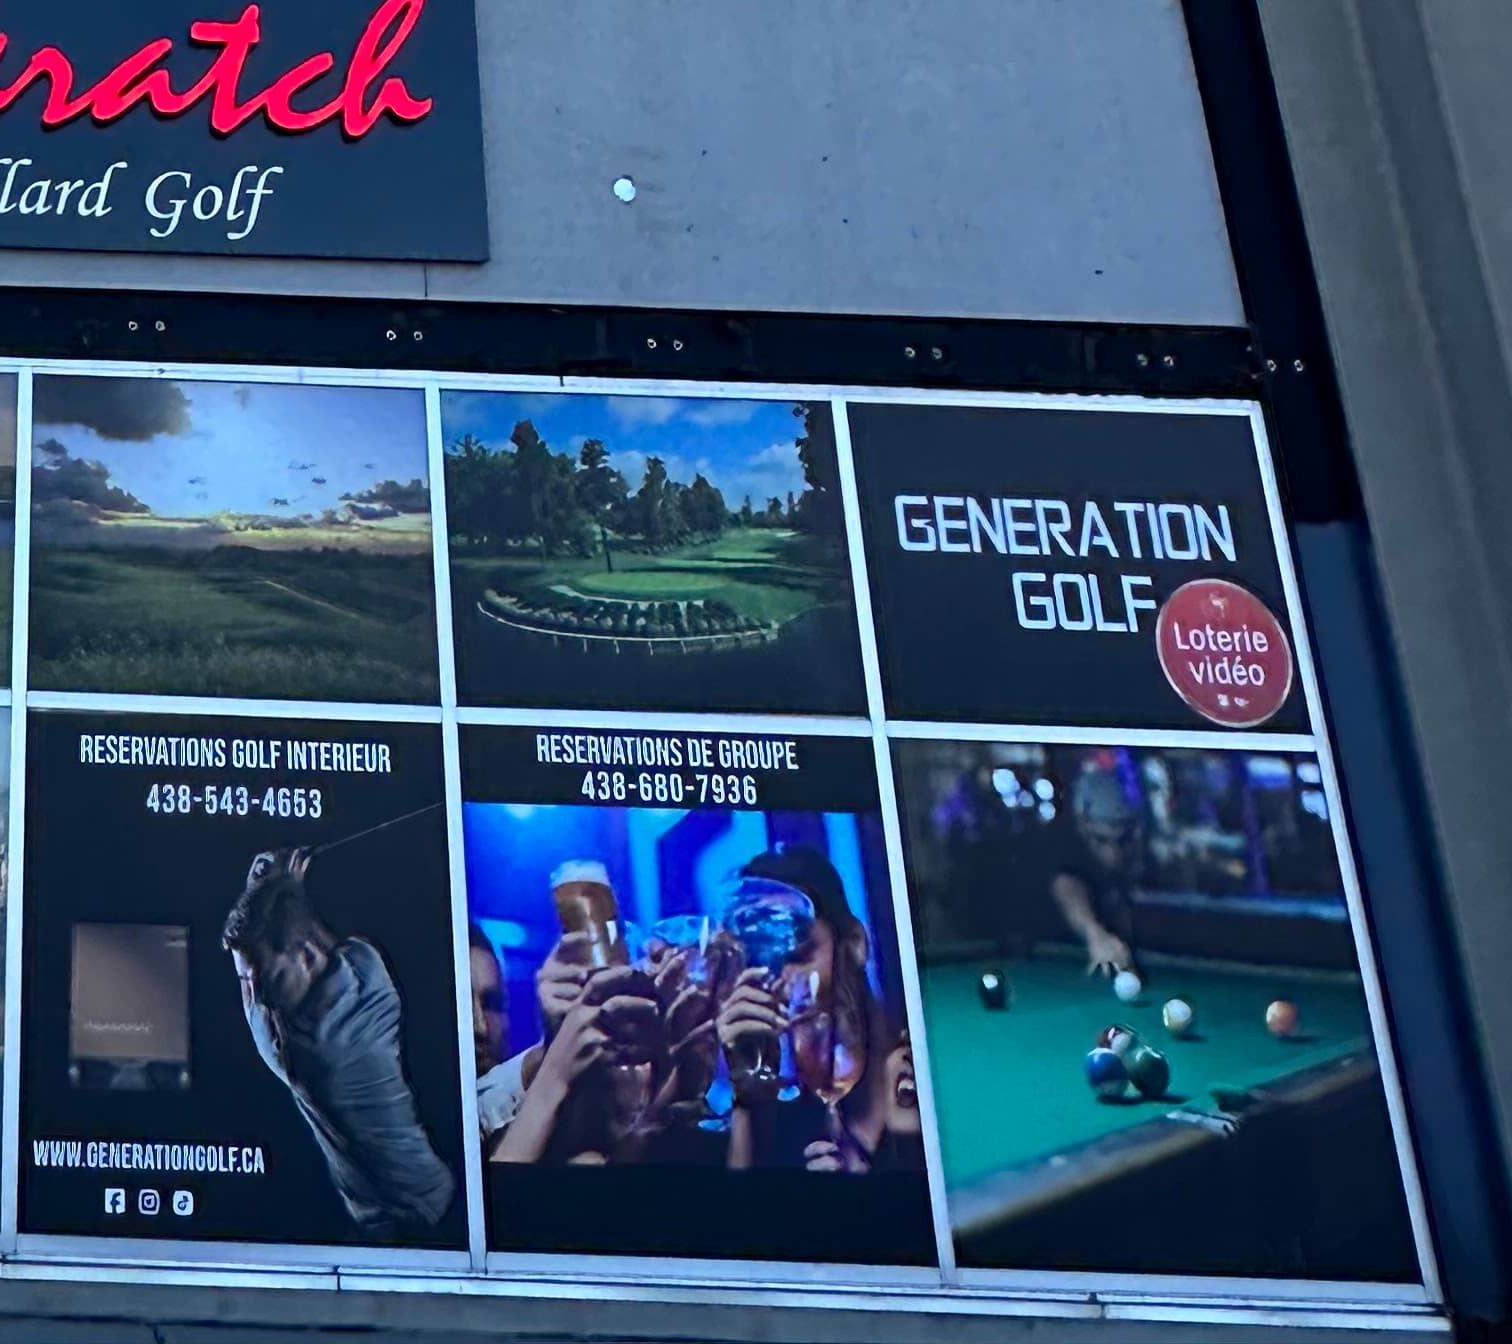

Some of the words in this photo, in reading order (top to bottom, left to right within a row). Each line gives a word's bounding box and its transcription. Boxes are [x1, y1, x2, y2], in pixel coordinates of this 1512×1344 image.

[145, 165, 285, 241] Golf
[894, 494, 1237, 562] GENERATION
[1011, 571, 1158, 633] GOLF
[1173, 620, 1269, 653] Loterie
[1188, 655, 1266, 687] vidéo
[80, 734, 227, 768] RESERVATIONS
[232, 739, 282, 769] GOLF
[287, 740, 392, 773] INTERIEUR
[536, 734, 683, 767] RESERVATIONS
[687, 738, 715, 768] DE
[718, 739, 800, 770] GROUPE
[146, 783, 323, 819] 438-543-4653
[581, 770, 758, 806] 438-680-7936
[33, 1139, 265, 1175] WWW.GENERATIONGOLF.CA
